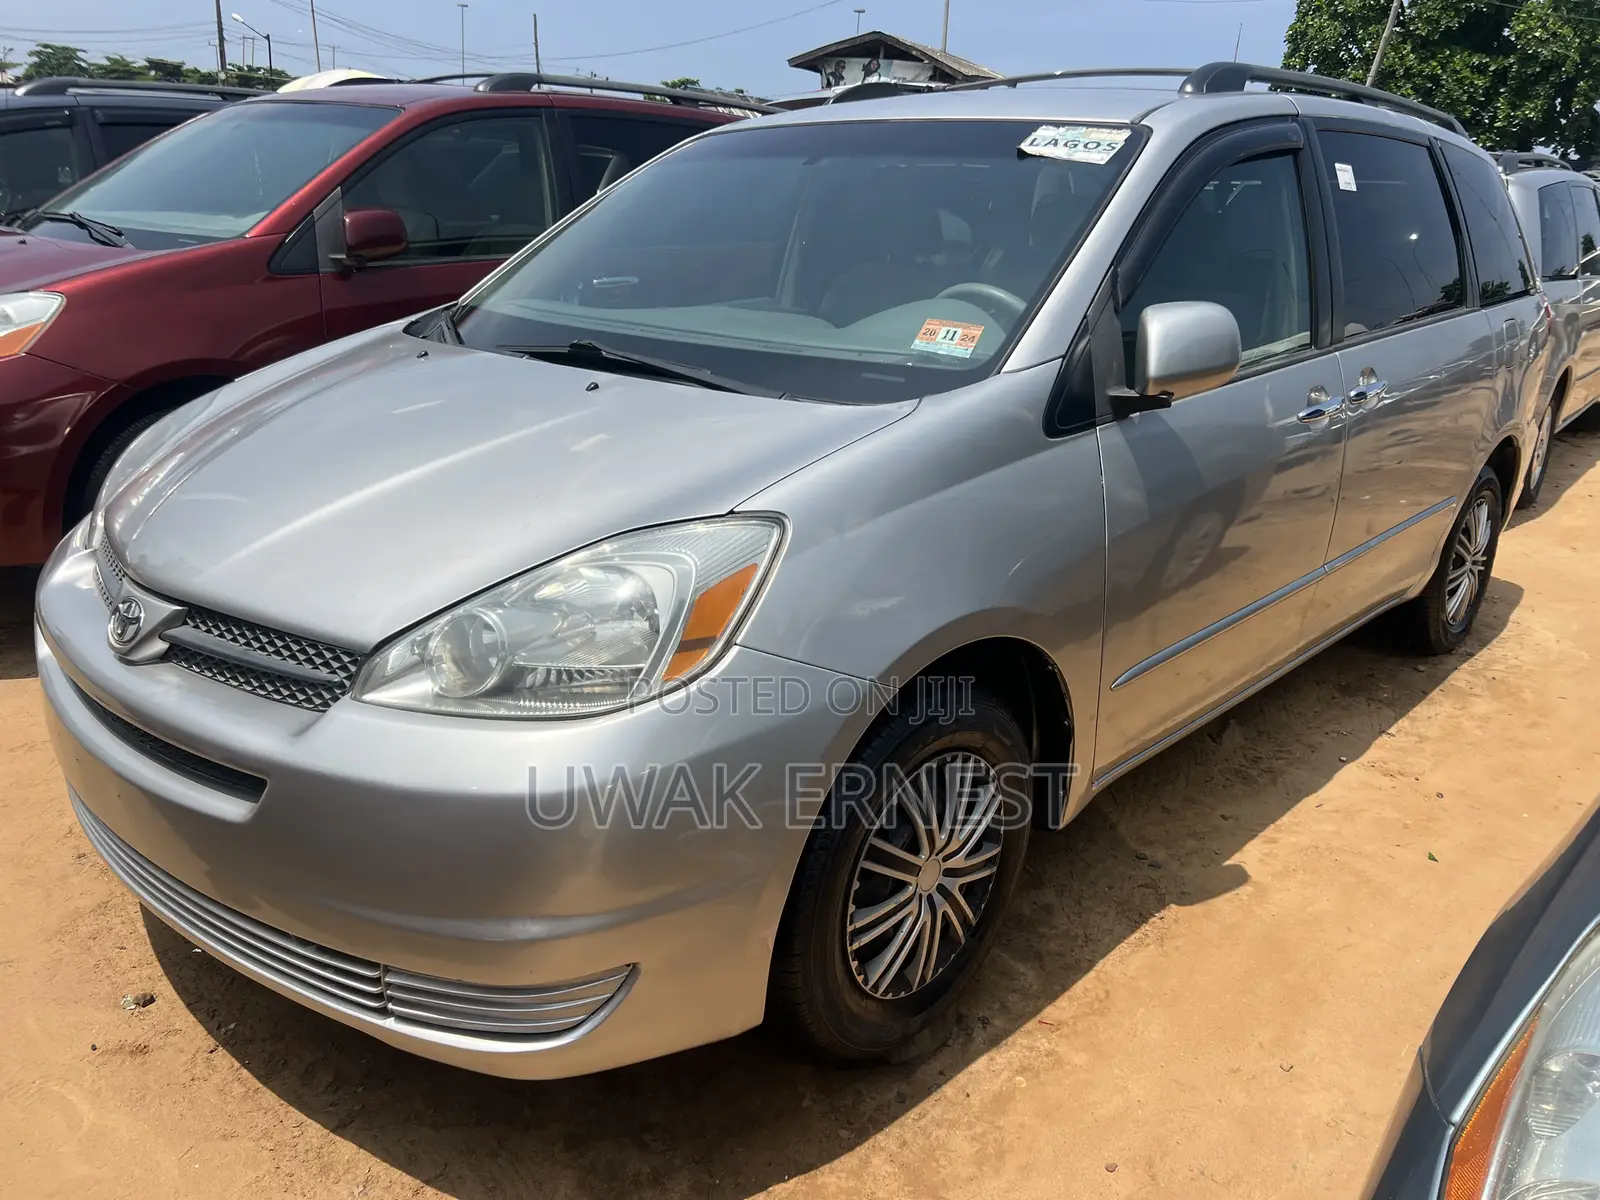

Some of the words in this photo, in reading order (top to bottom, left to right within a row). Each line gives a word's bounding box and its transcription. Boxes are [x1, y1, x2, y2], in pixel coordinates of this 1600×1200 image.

[1028, 138, 1119, 152] LAGOS
[923, 328, 937, 337] 20
[941, 329, 958, 342] 11
